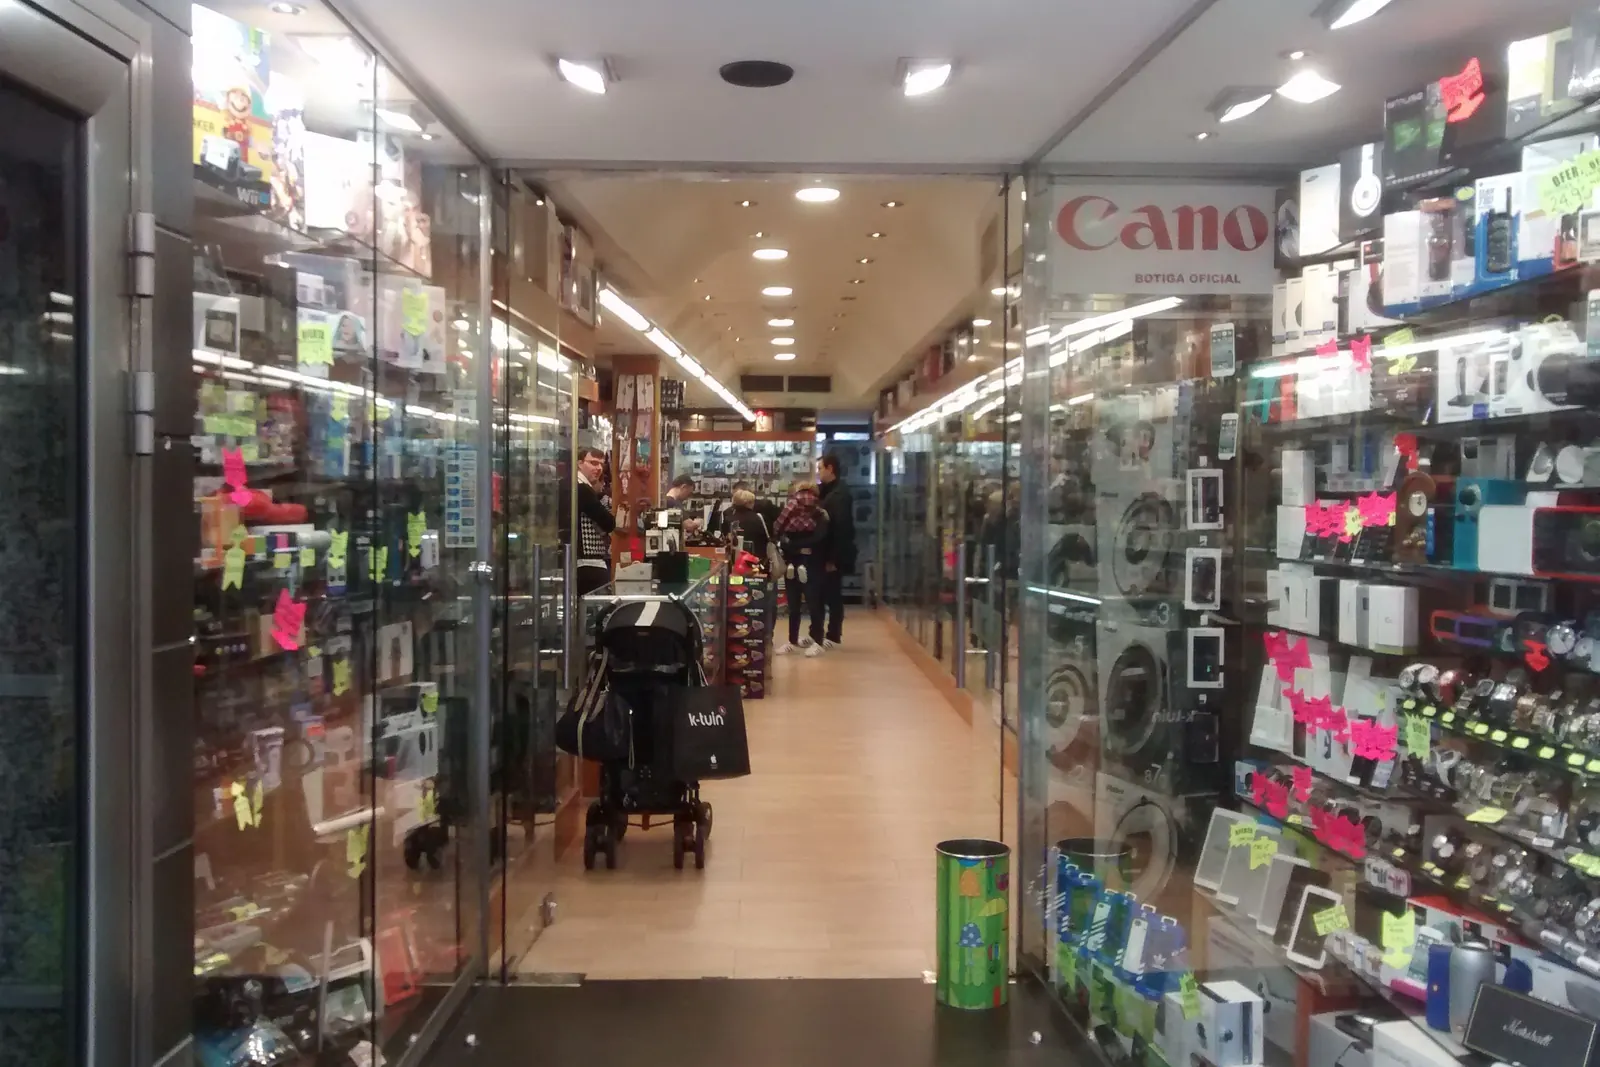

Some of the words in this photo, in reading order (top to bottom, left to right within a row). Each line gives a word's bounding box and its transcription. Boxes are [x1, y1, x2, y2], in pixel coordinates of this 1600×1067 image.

[1056, 195, 1269, 252] Cano
[1135, 273, 1185, 284] BOTIGA
[1189, 273, 1241, 284] OFICIAL
[688, 711, 725, 726] k-tuin
